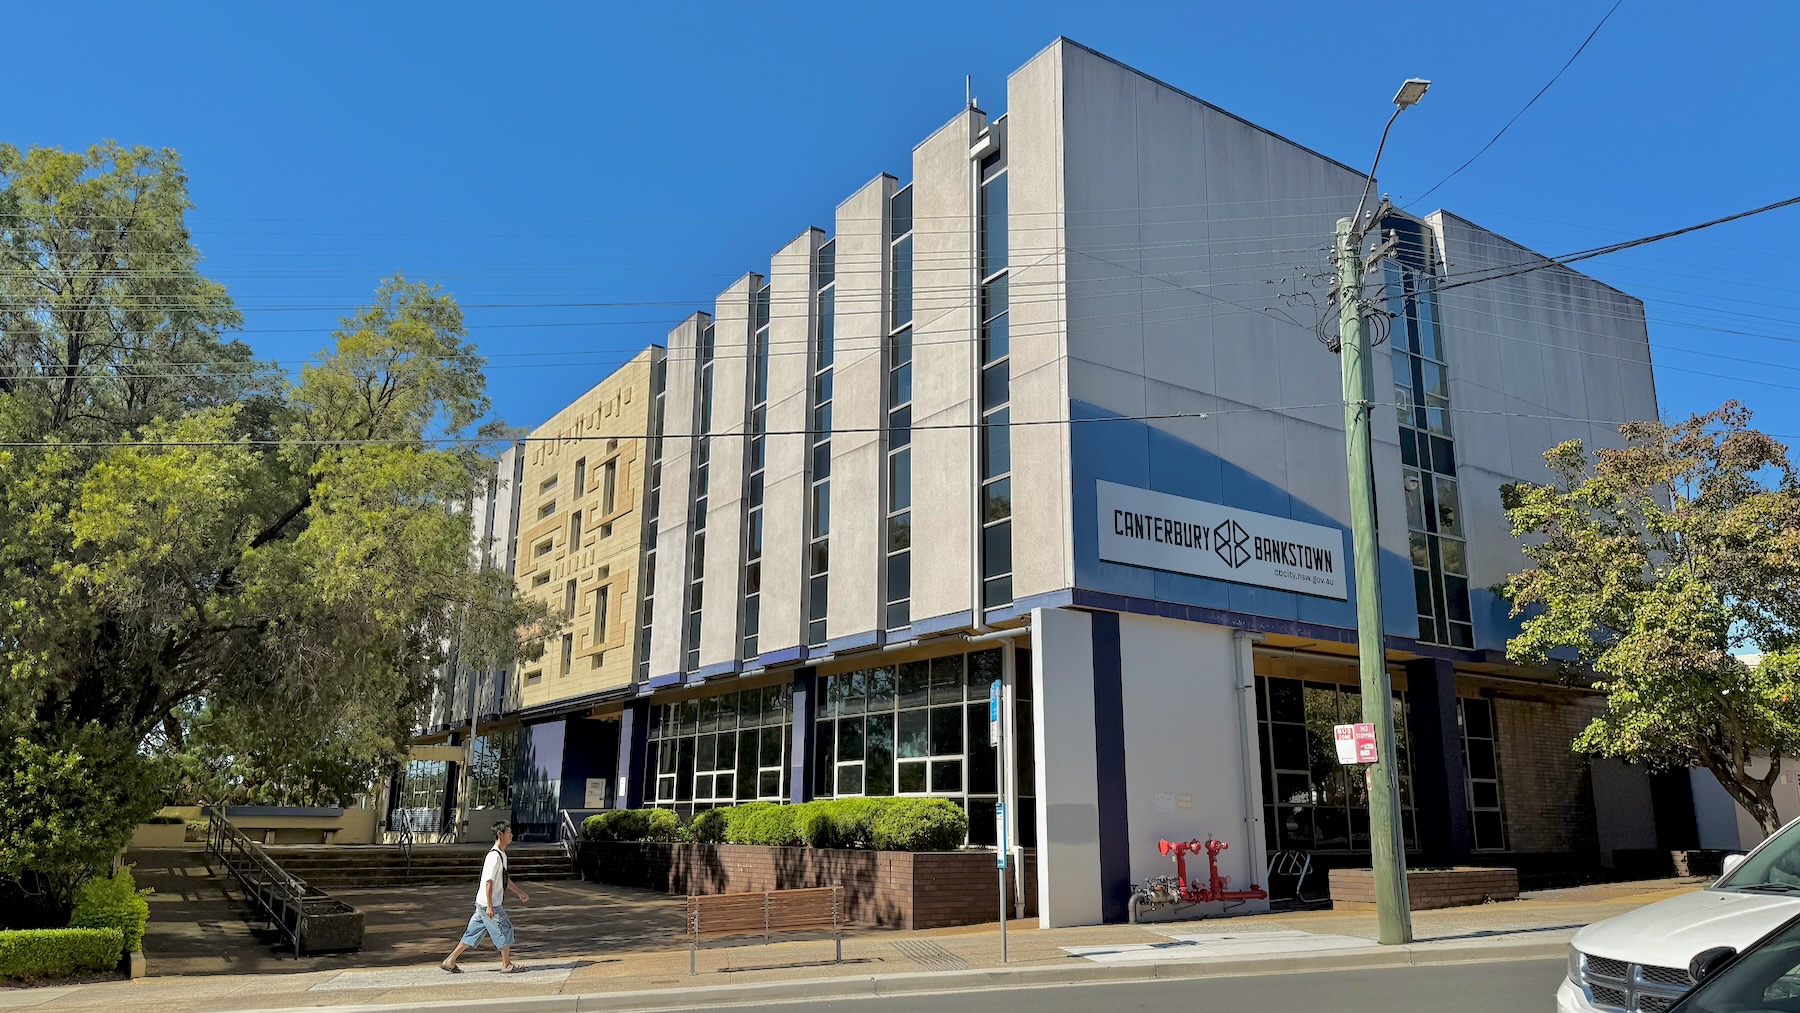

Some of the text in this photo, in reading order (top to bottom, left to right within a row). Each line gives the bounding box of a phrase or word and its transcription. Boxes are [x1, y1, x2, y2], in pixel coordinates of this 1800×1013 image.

[1114, 509, 1333, 574] CANTERBURY BANKSTOWN
[1273, 569, 1334, 586] cbcity.nsw.gov.au
